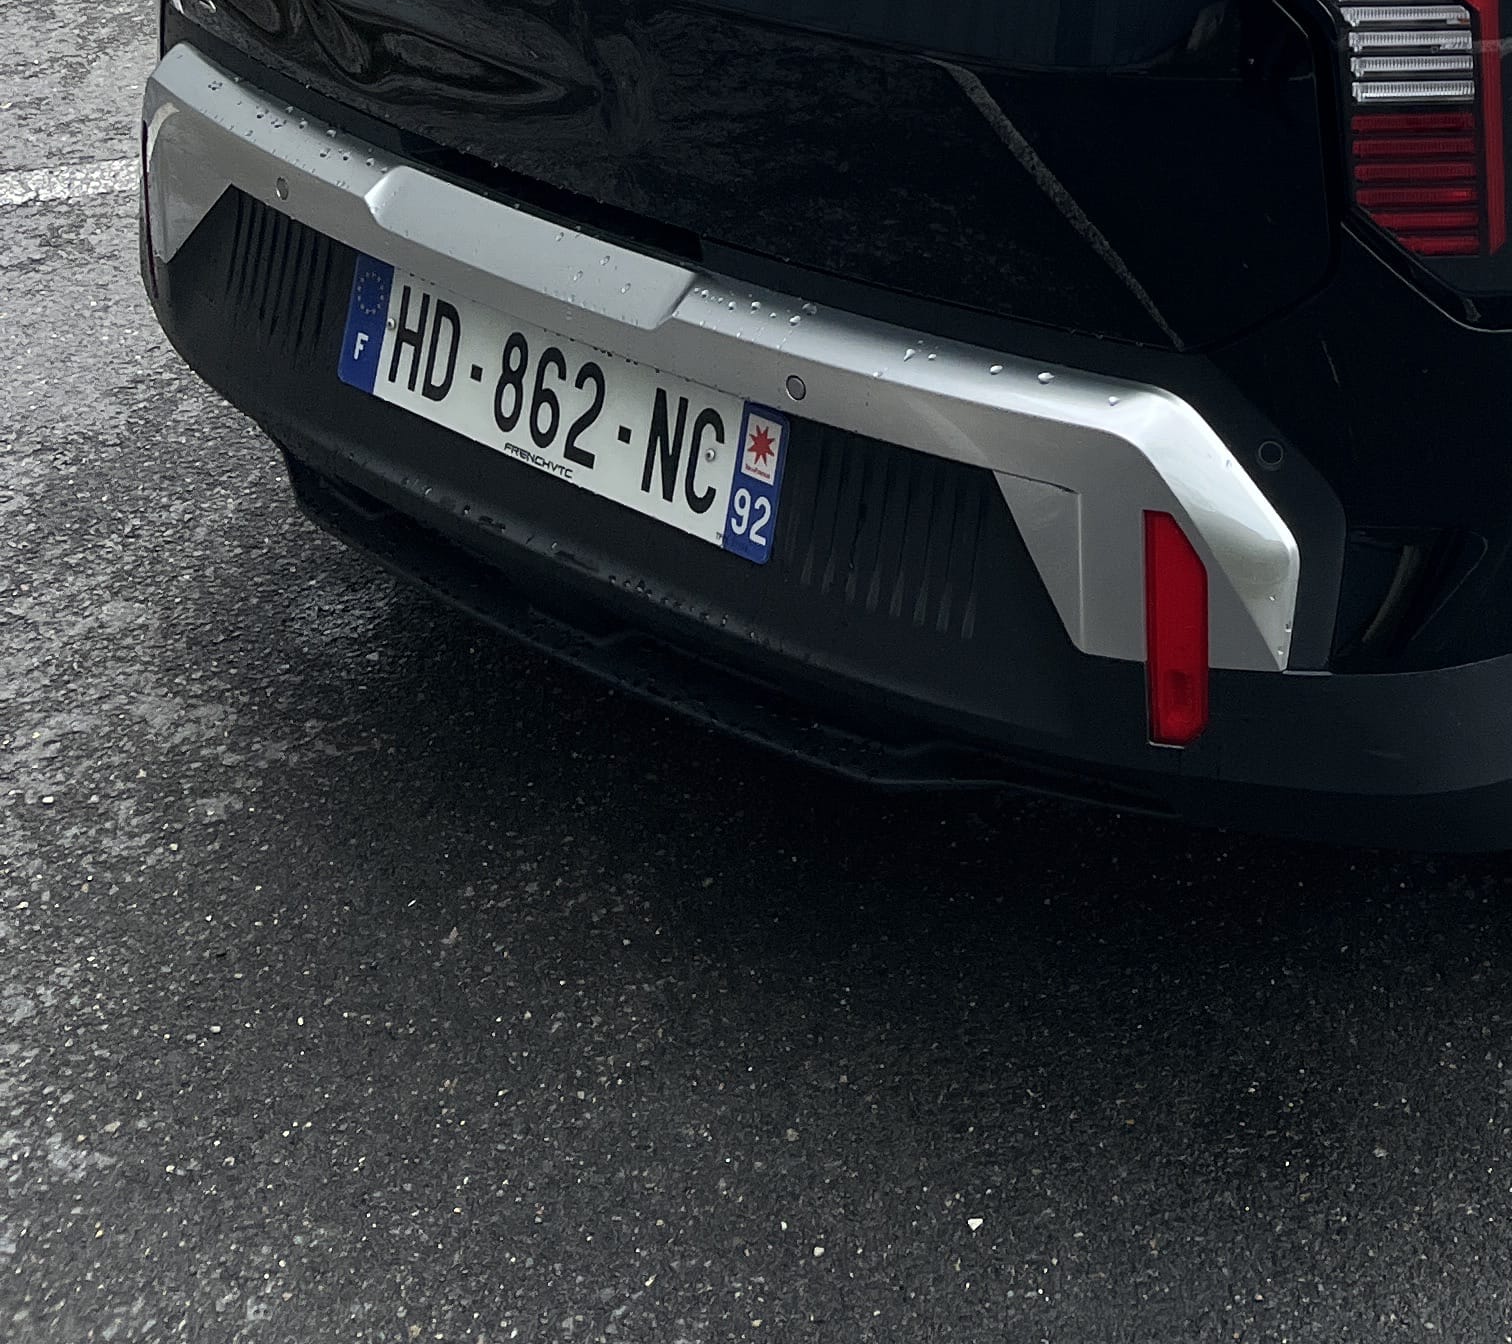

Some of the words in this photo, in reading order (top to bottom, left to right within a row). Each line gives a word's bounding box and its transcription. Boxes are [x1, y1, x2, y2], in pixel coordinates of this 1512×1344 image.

[352, 332, 369, 360] F
[388, 285, 725, 514] HD-862-NC
[730, 487, 773, 547] 92
